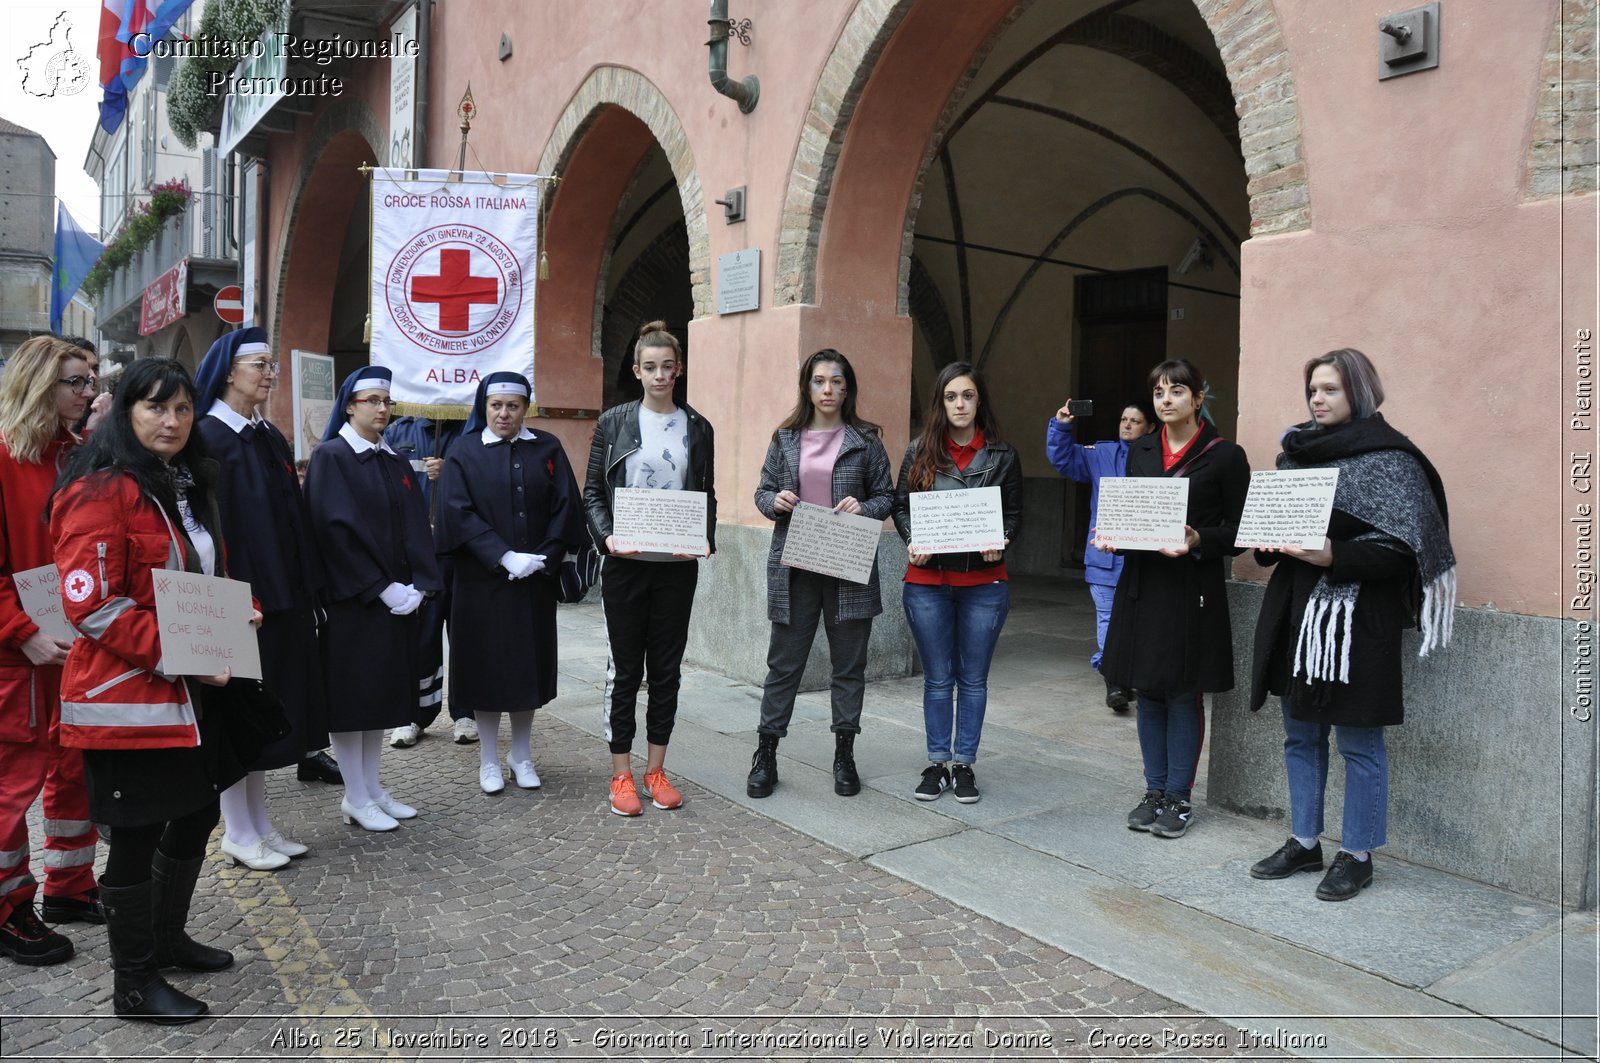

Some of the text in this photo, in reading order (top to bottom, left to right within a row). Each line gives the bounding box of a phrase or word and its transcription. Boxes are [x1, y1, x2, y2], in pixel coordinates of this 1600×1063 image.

[384, 195, 527, 210] CROCE ROSSA ITALIANA
[391, 238, 427, 284] CONVENZIONE
[427, 234, 437, 243] DI
[438, 229, 473, 240] GINEVRA
[476, 235, 486, 245] 22
[486, 241, 513, 269] AGOSTO
[394, 306, 514, 351] CORPO INFERMIERE VOLONTARIE
[426, 369, 481, 383] ALBA
[177, 581, 201, 596] NON
[177, 600, 227, 619] NORMALE
[168, 622, 213, 637] CHE SIA
[190, 643, 234, 659] NORMALE
